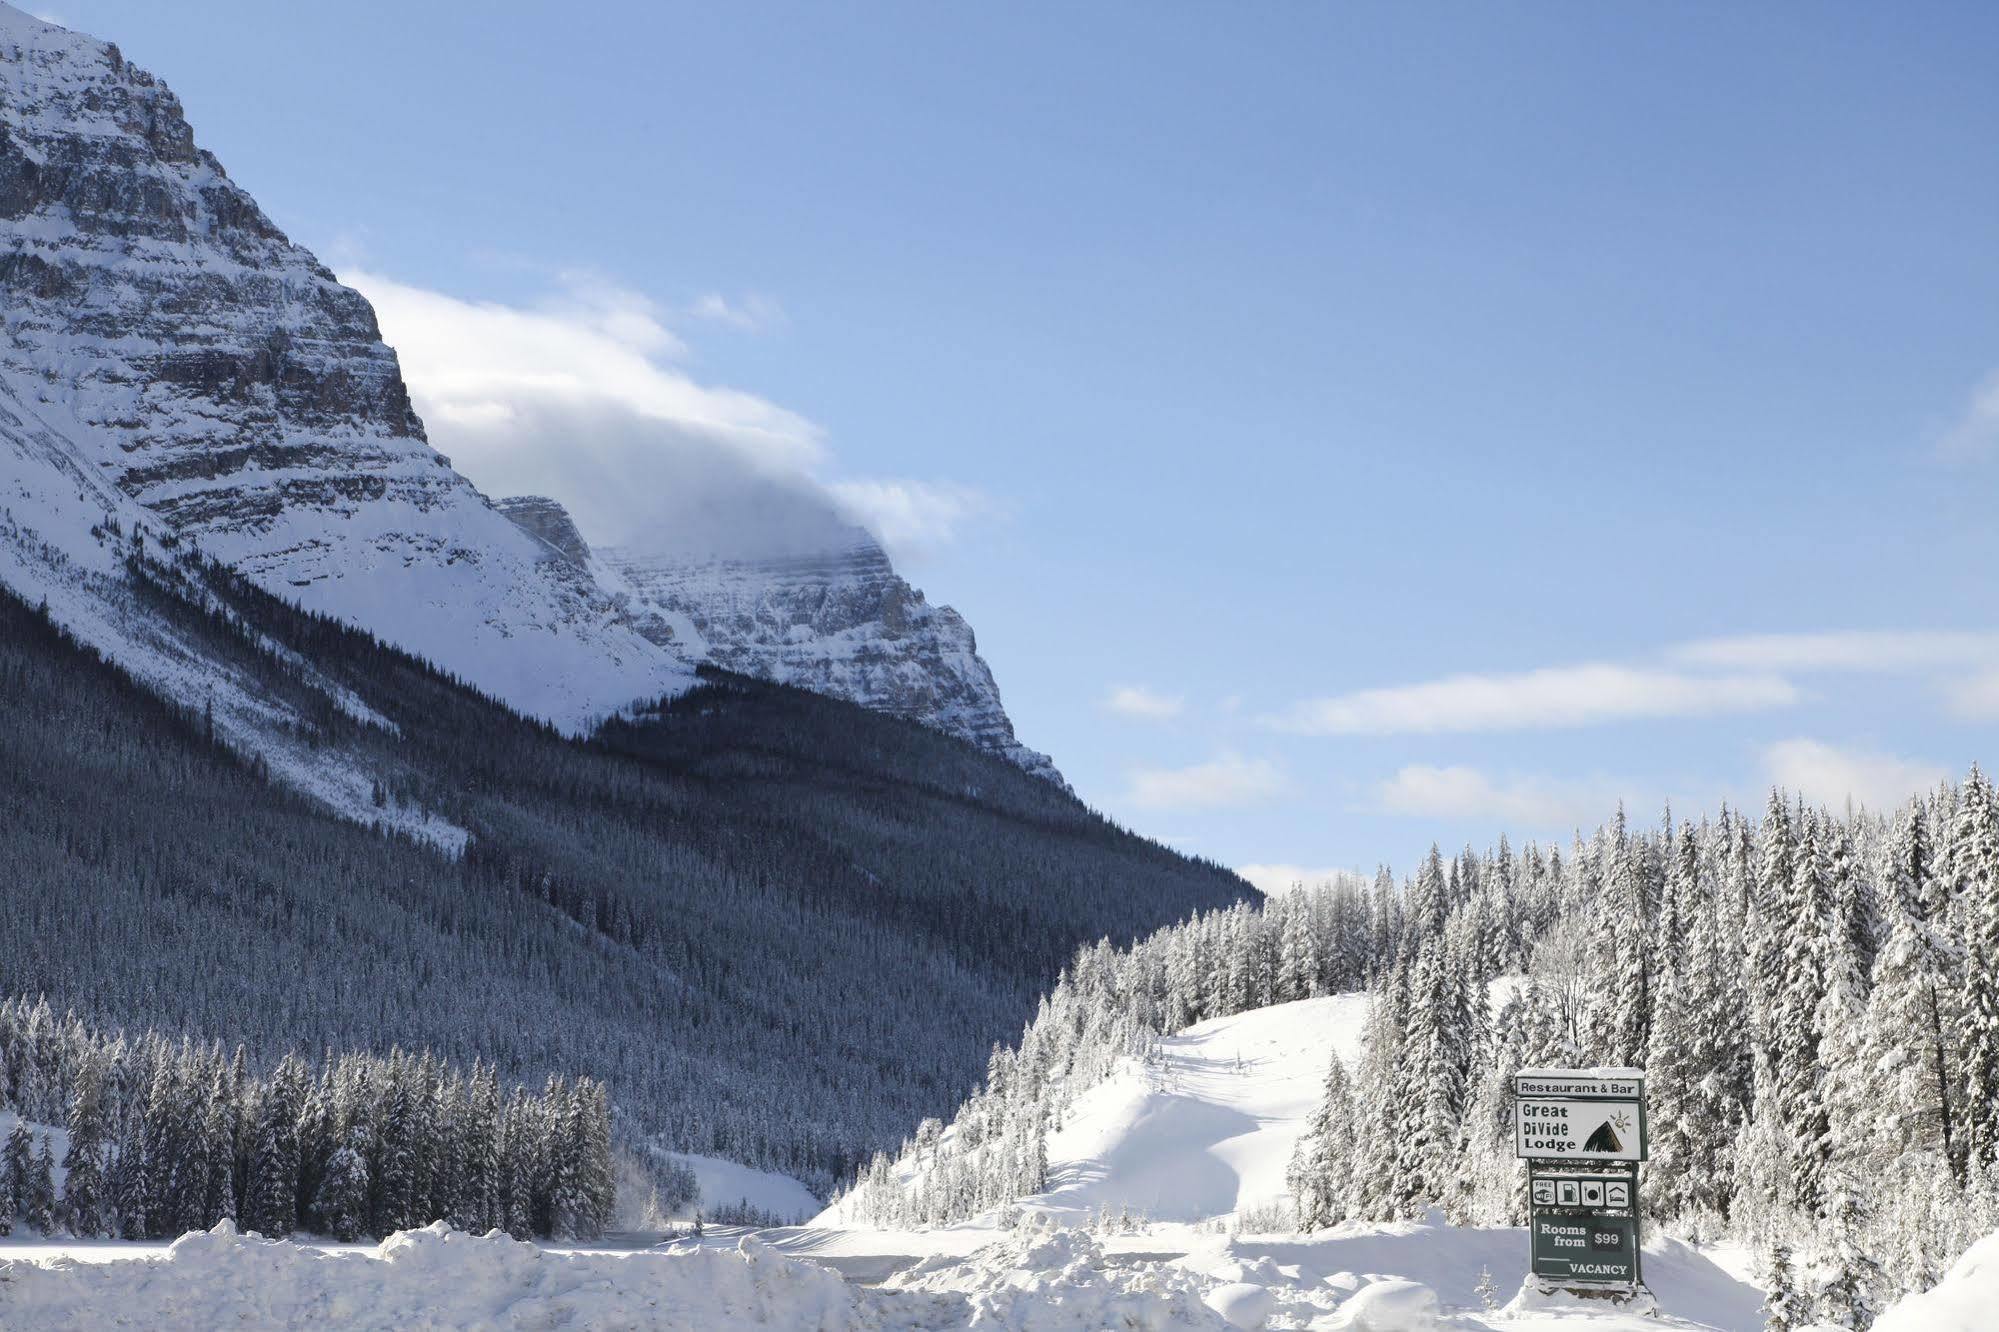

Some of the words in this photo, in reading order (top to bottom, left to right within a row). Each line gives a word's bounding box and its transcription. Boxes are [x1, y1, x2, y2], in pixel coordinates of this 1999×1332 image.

[1521, 1082, 1598, 1093] Restaurant
[1600, 1084, 1608, 1093] &
[1611, 1084, 1635, 1094] Bar
[1523, 1104, 1568, 1118] Great
[1525, 1138, 1576, 1152] Lodge
[1541, 1223, 1586, 1235] Rooms
[1554, 1235, 1586, 1247] from
[1594, 1233, 1619, 1245] $99
[1569, 1263, 1627, 1275] VACANCY
